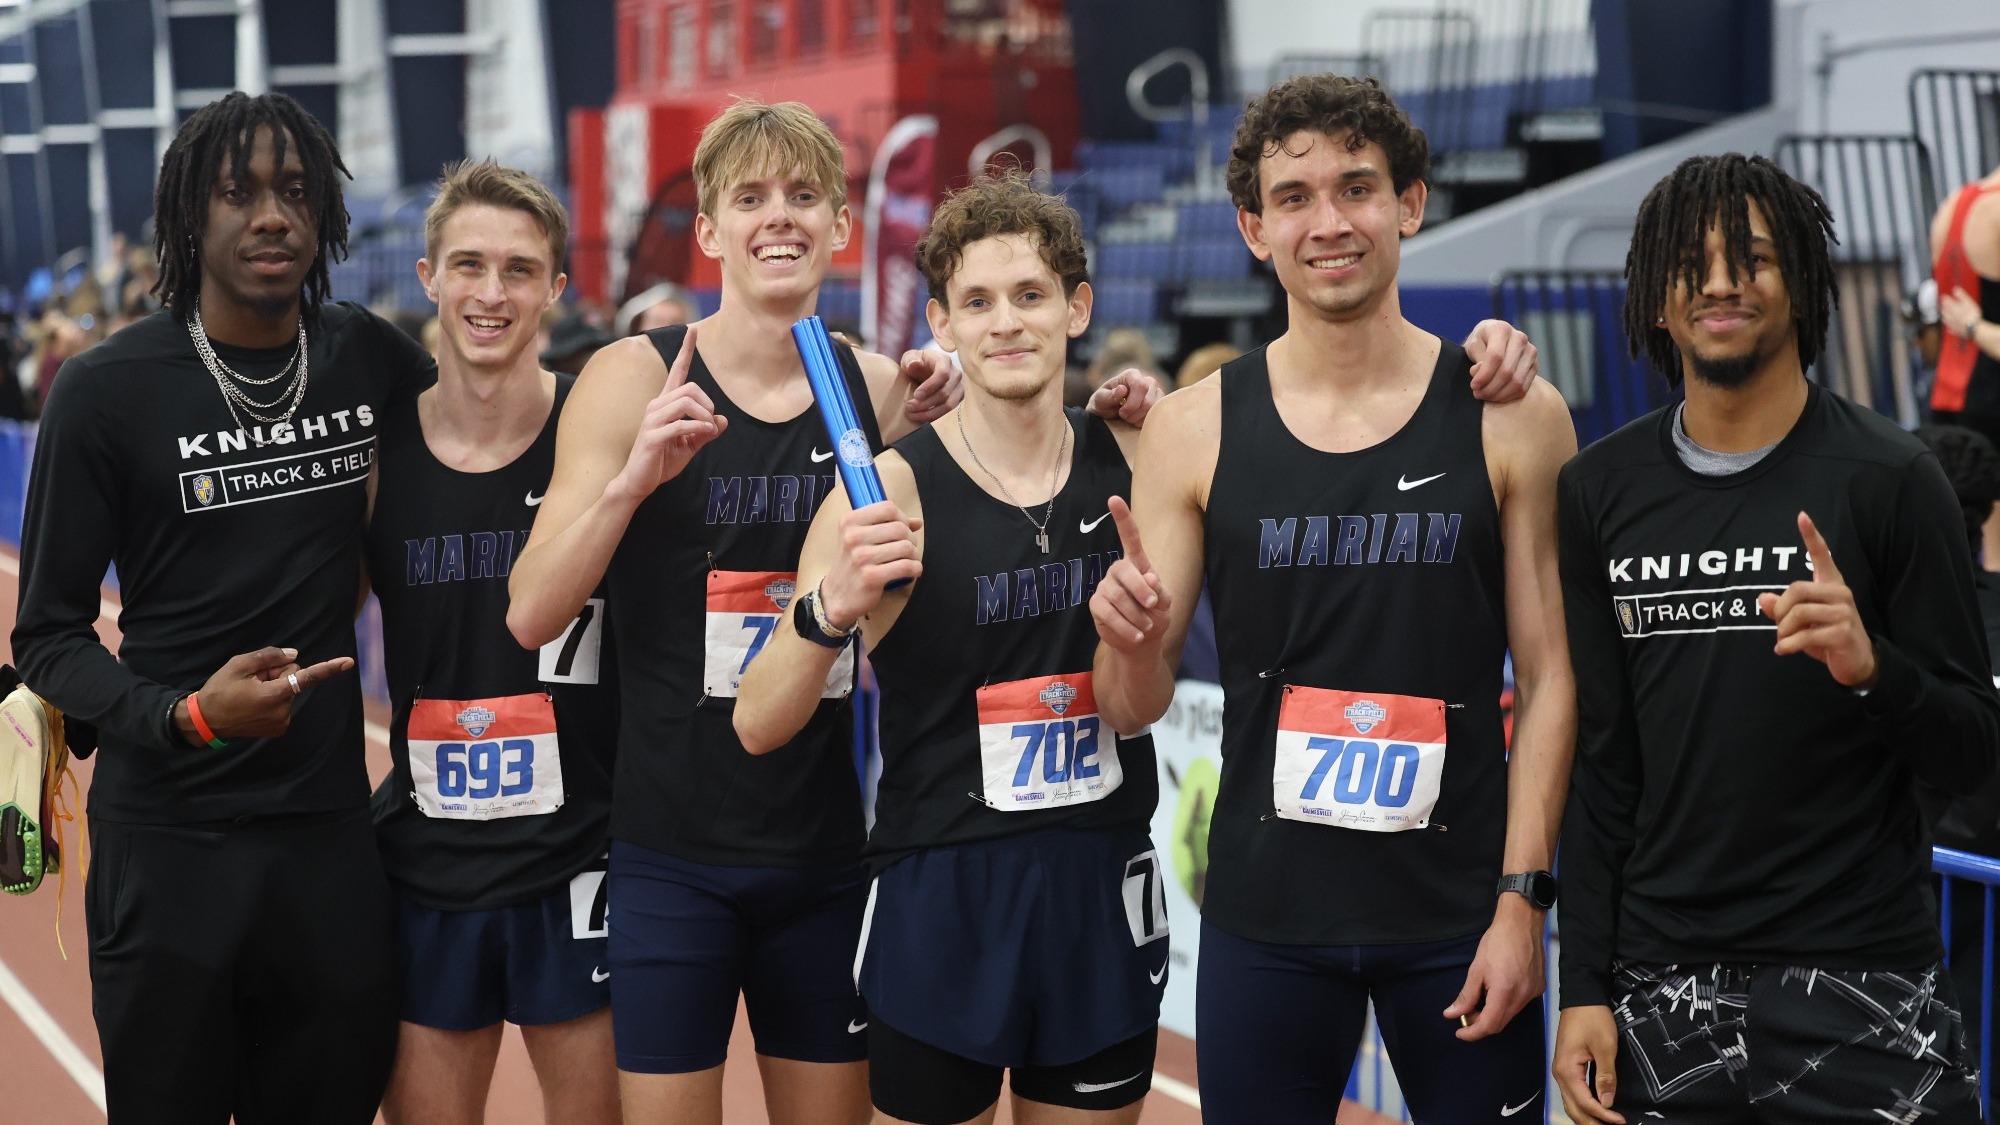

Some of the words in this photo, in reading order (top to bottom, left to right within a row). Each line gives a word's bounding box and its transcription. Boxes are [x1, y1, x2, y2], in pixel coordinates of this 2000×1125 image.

[178, 405, 375, 459] KNIGHTS
[228, 465, 305, 493] TRACK
[310, 461, 327, 479] &
[404, 530, 532, 586] MARI
[1258, 512, 1462, 569] MARIAN
[973, 550, 1121, 626] MARIA
[1643, 599, 1726, 624] TRACK
[1729, 598, 1747, 617] &
[554, 605, 594, 677] 7
[738, 616, 783, 675] 7
[436, 738, 535, 800] 693
[1010, 716, 1101, 788] 702
[1299, 736, 1420, 808] 700
[1015, 791, 1046, 802] GAINESVILLE
[1302, 806, 1333, 817] GAINESVILLE
[1127, 857, 1155, 938] 7
